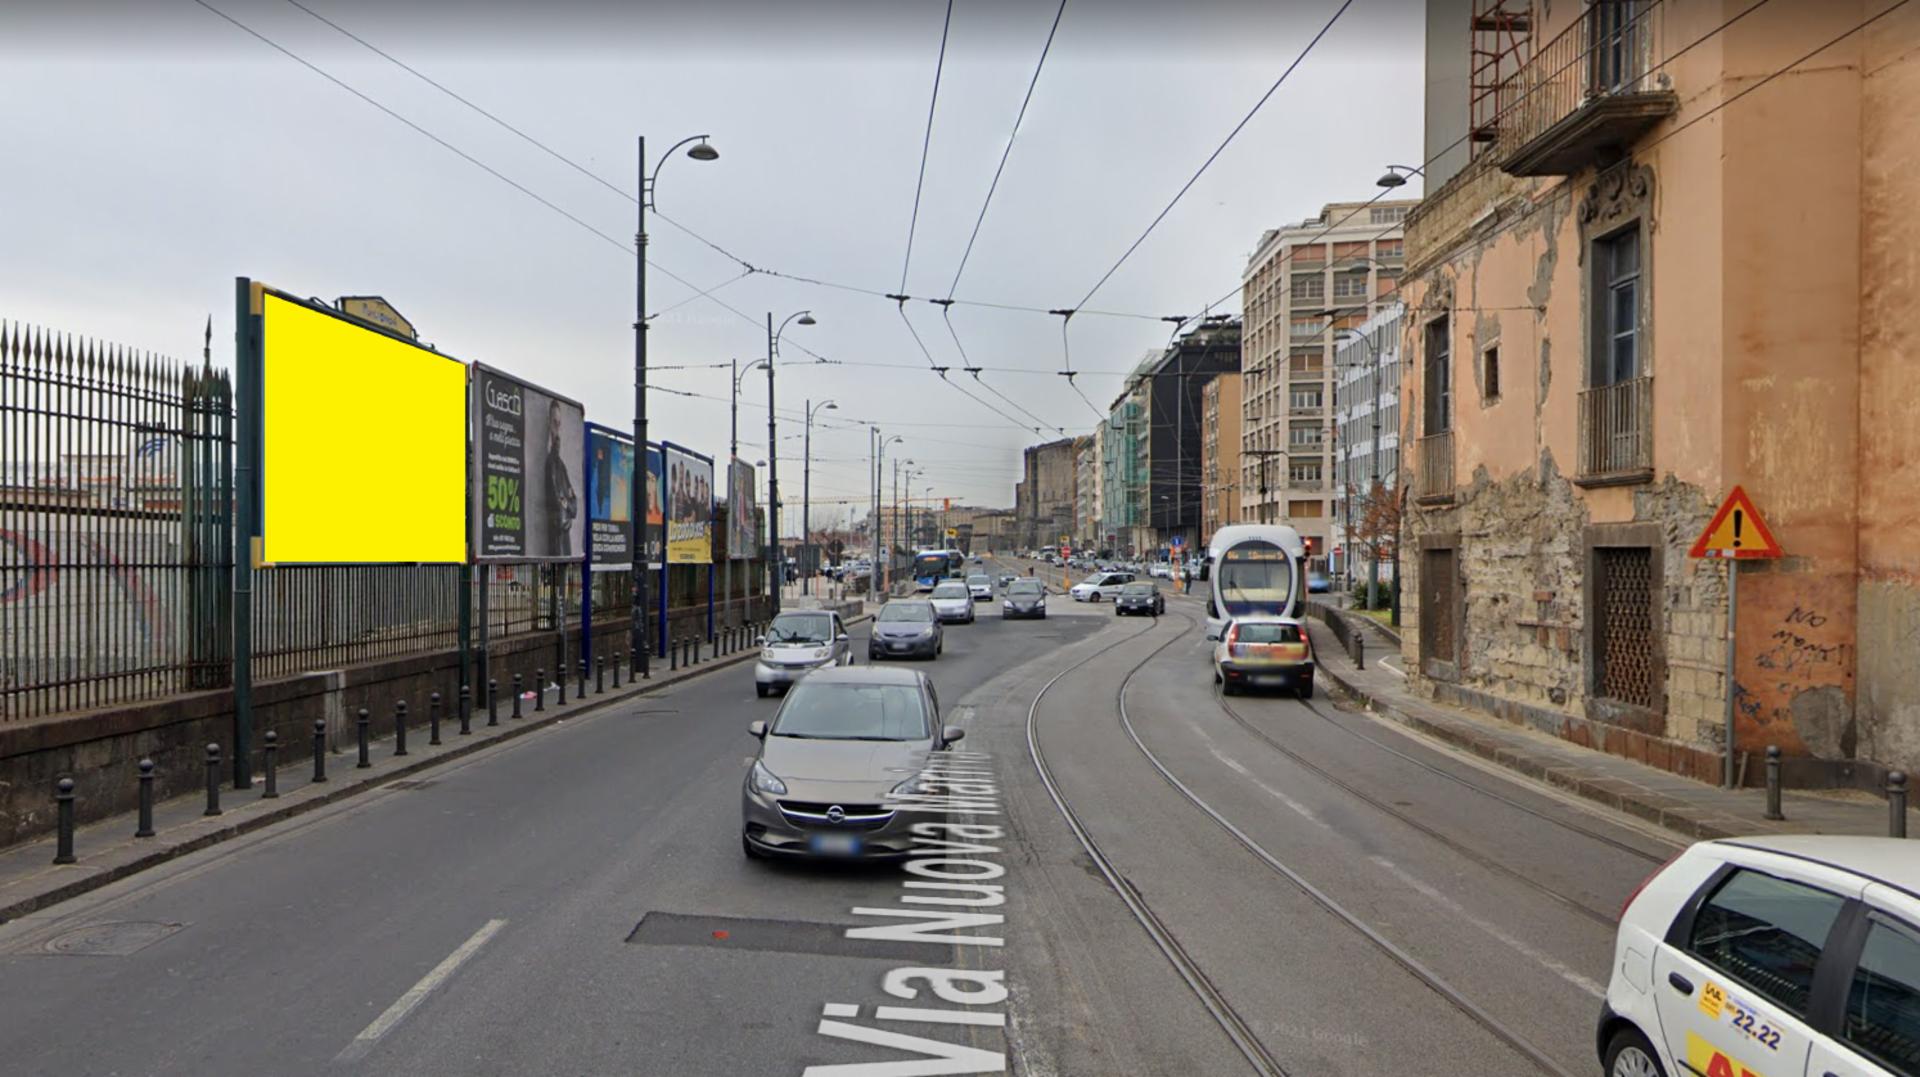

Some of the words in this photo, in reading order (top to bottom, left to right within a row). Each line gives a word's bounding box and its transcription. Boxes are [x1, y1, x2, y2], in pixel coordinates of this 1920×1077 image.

[488, 475, 520, 513] 50%
[1785, 606, 1828, 628] NO
[1732, 1009, 1782, 1051] 22.22
